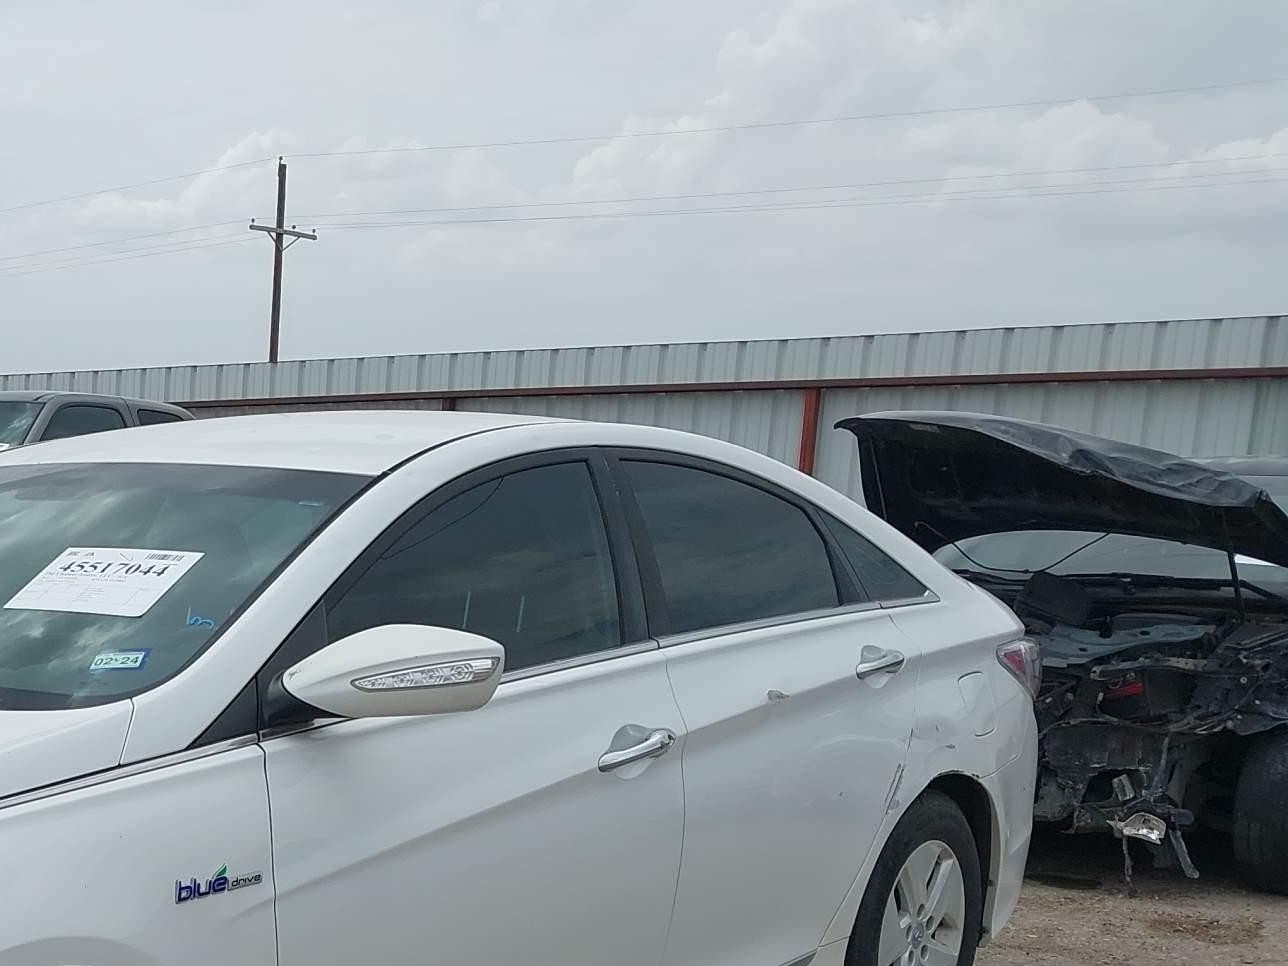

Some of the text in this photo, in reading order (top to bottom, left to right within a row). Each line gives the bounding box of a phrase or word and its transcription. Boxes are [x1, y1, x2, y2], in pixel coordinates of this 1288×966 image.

[59, 560, 170, 577] 45517044
[175, 873, 261, 904] blue drive
